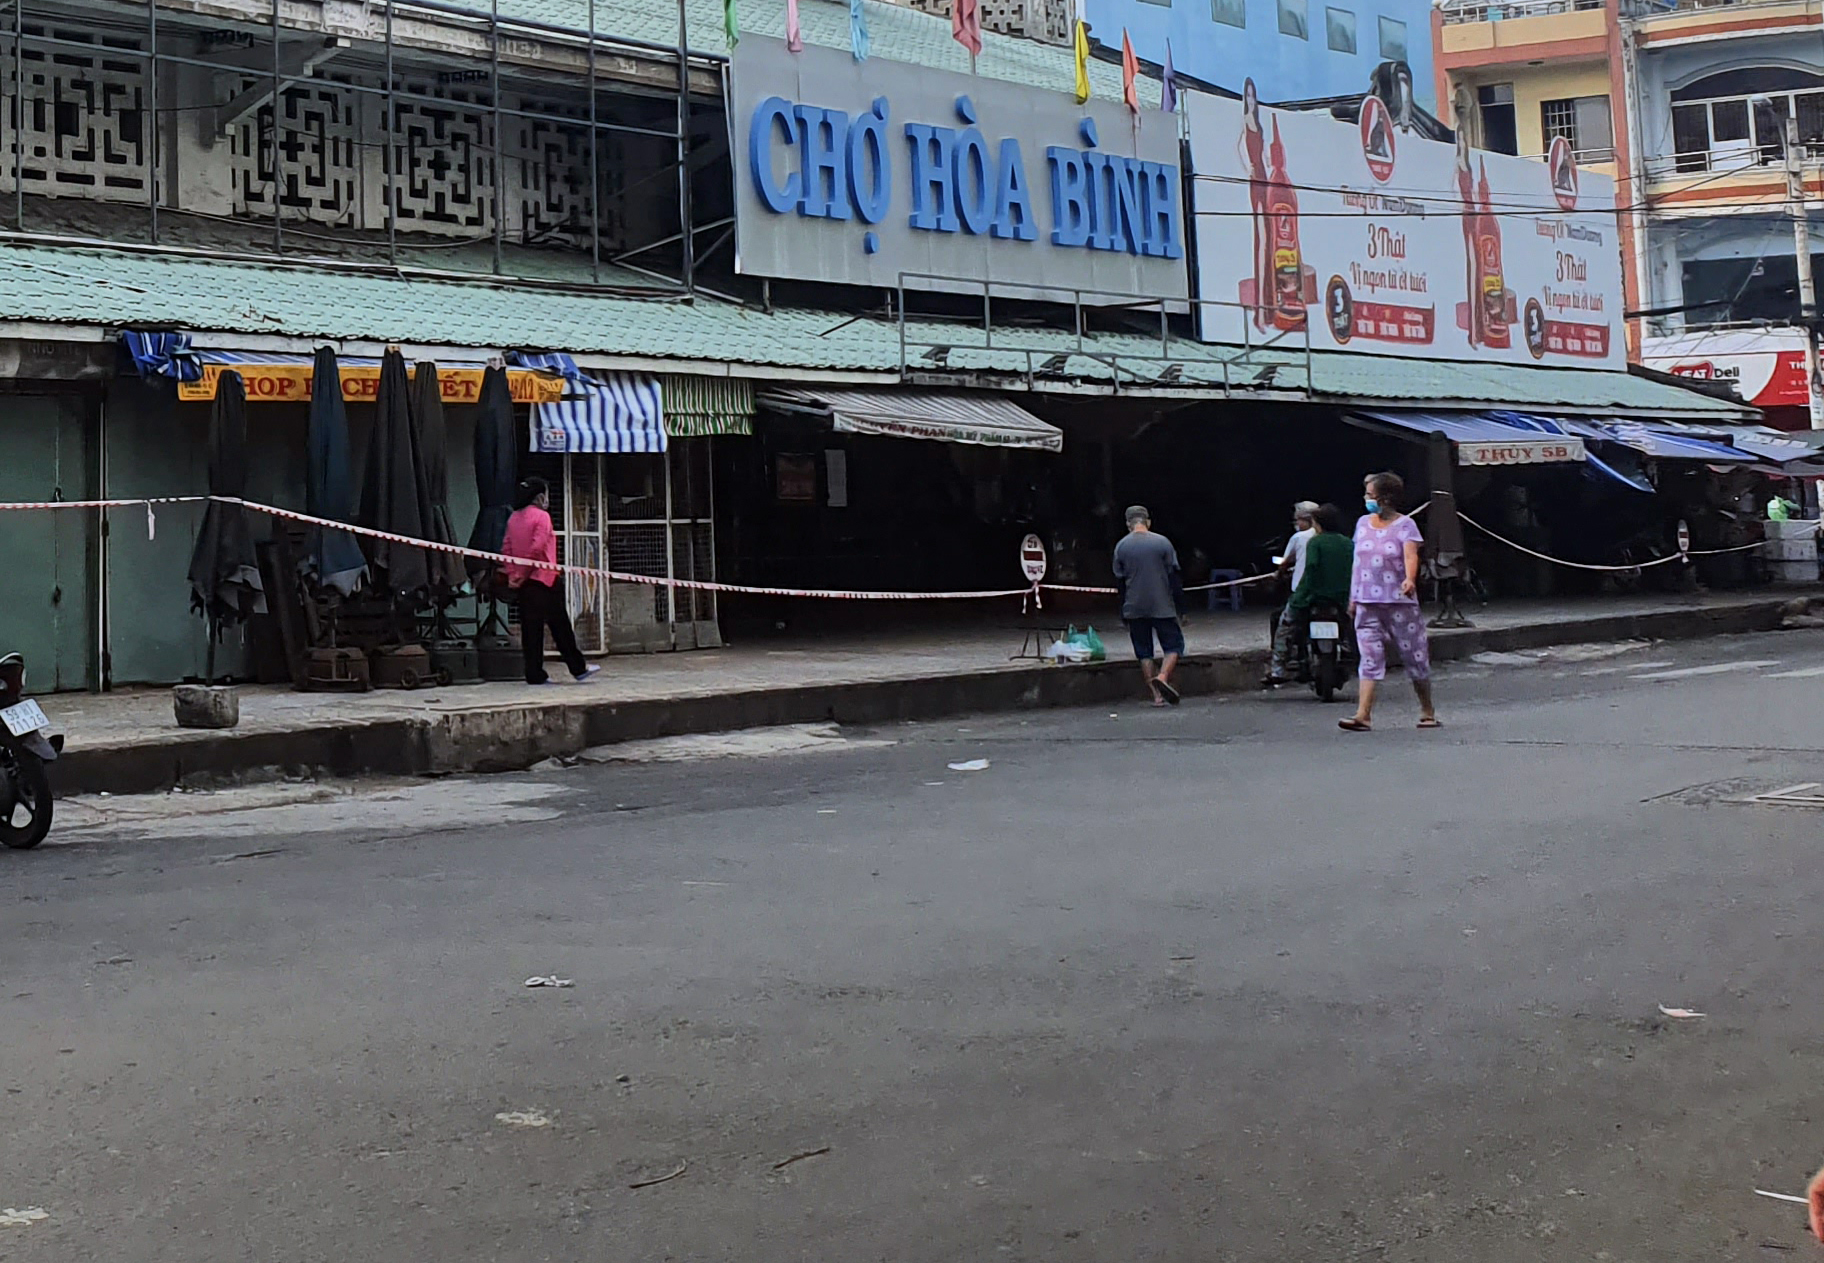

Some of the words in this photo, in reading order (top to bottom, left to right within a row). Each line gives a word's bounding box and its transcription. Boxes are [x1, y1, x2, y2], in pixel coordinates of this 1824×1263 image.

[749, 96, 892, 254] CHỢ
[905, 95, 1038, 241] HÒA
[1047, 117, 1183, 259] BÌNH
[242, 377, 295, 396] HOP
